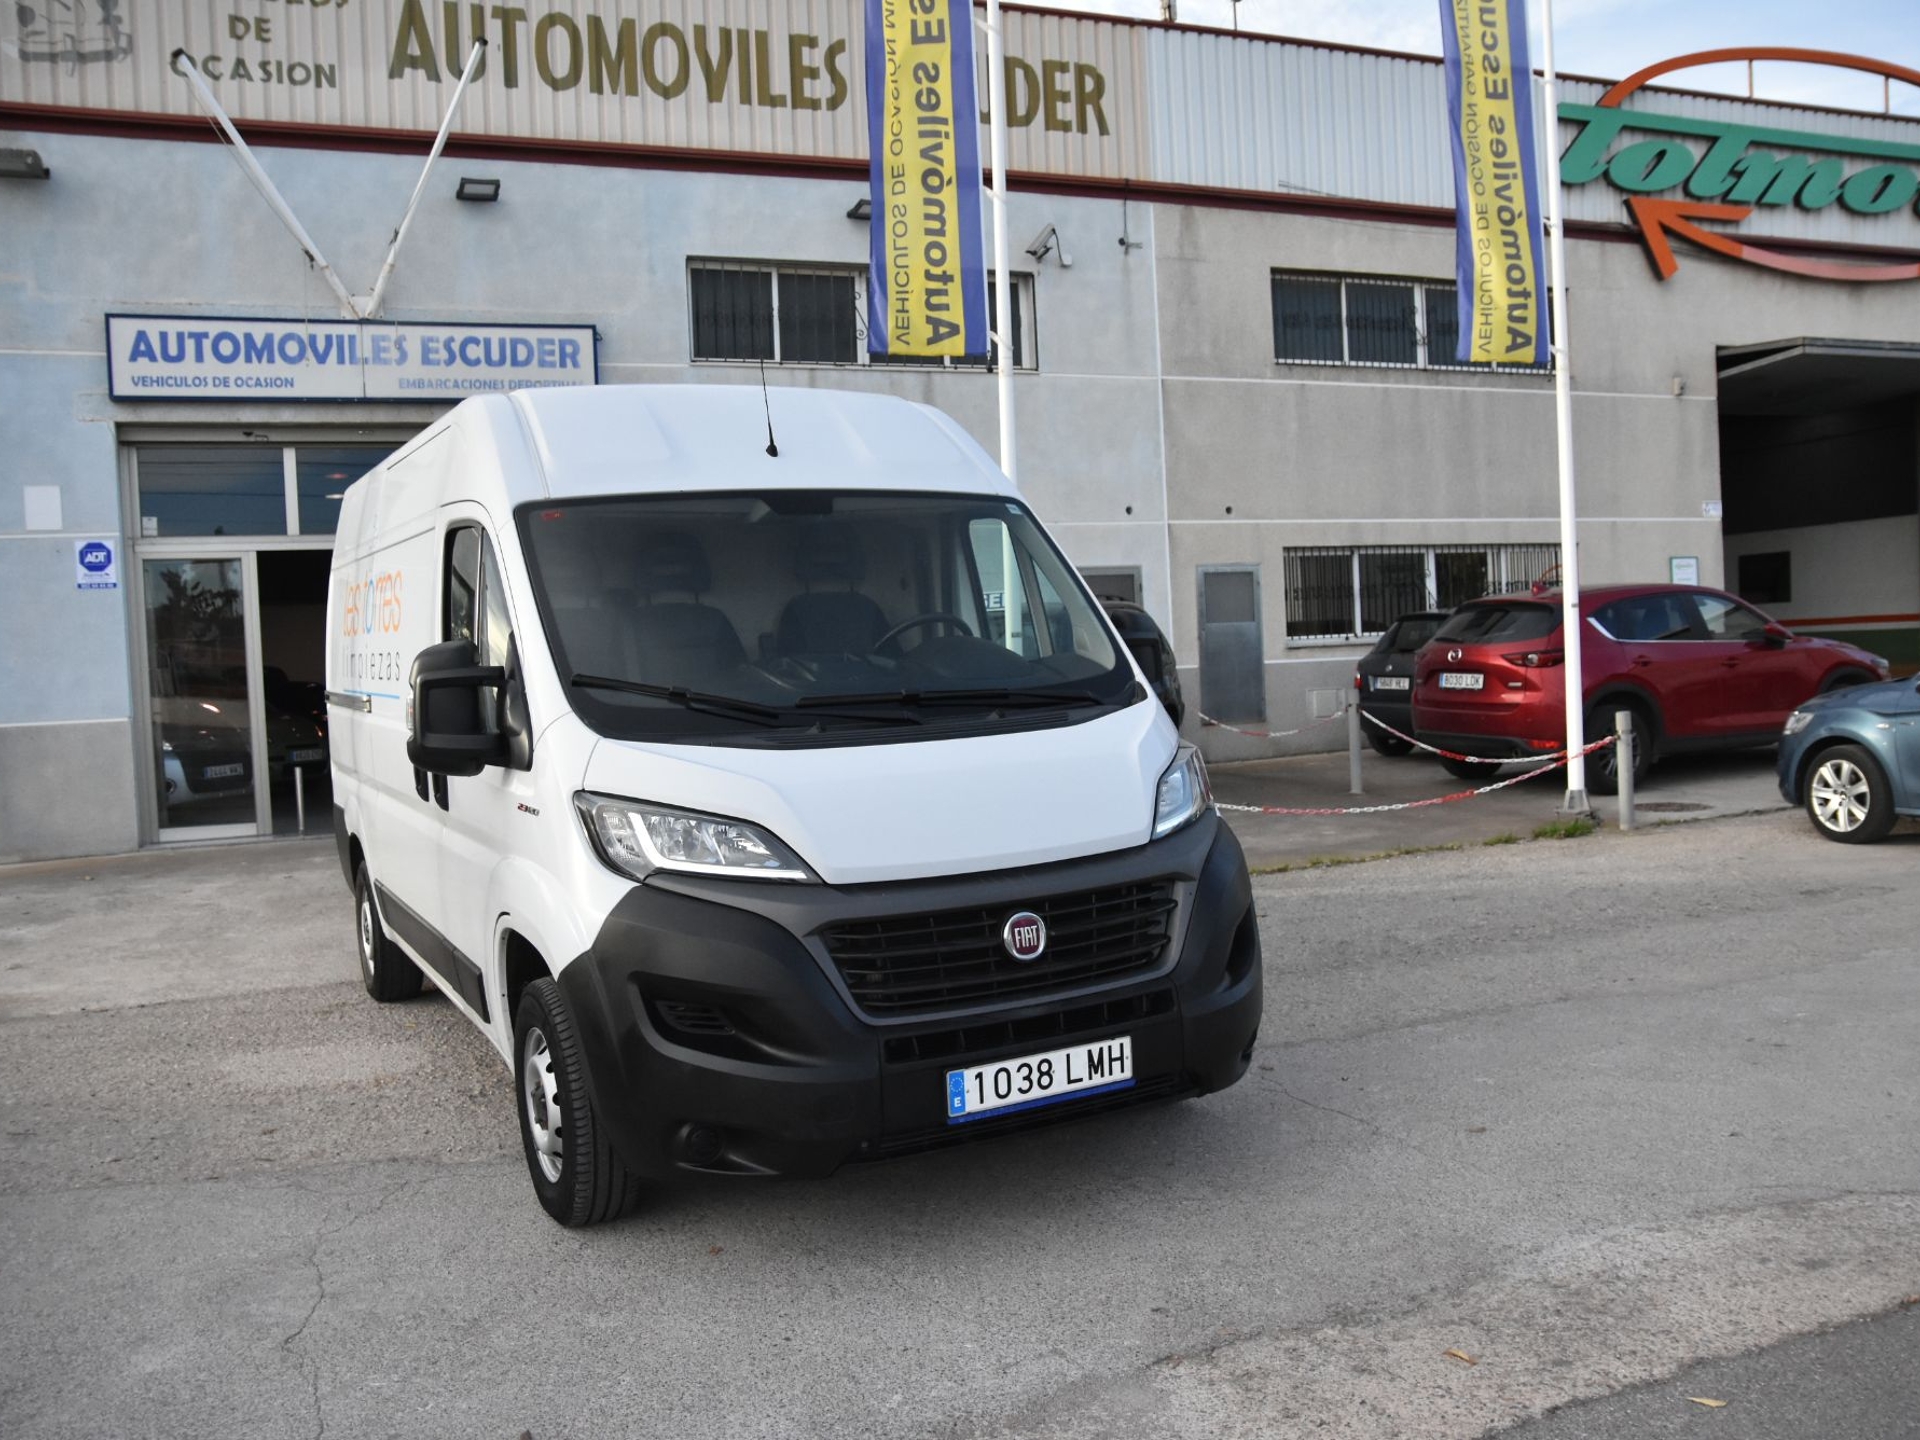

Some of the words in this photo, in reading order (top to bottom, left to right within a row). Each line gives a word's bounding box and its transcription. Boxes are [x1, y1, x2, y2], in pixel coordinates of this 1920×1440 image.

[228, 14, 272, 43] DE
[388, 0, 848, 111] AUTOMOVILES
[170, 53, 337, 89] OCASION
[128, 330, 408, 367] AUTOMOVILES
[420, 335, 581, 369] ESCUDER
[132, 375, 208, 388] VEHICULOS
[213, 376, 230, 388] DE
[234, 376, 295, 388] OCASION
[398, 377, 505, 390] EMBARCACIONES
[84, 551, 107, 563] ADT
[1014, 925, 1038, 949] FIAT
[954, 1096, 962, 1108] E
[974, 1057, 1054, 1105] 1038
[1065, 1042, 1125, 1085] LMH
